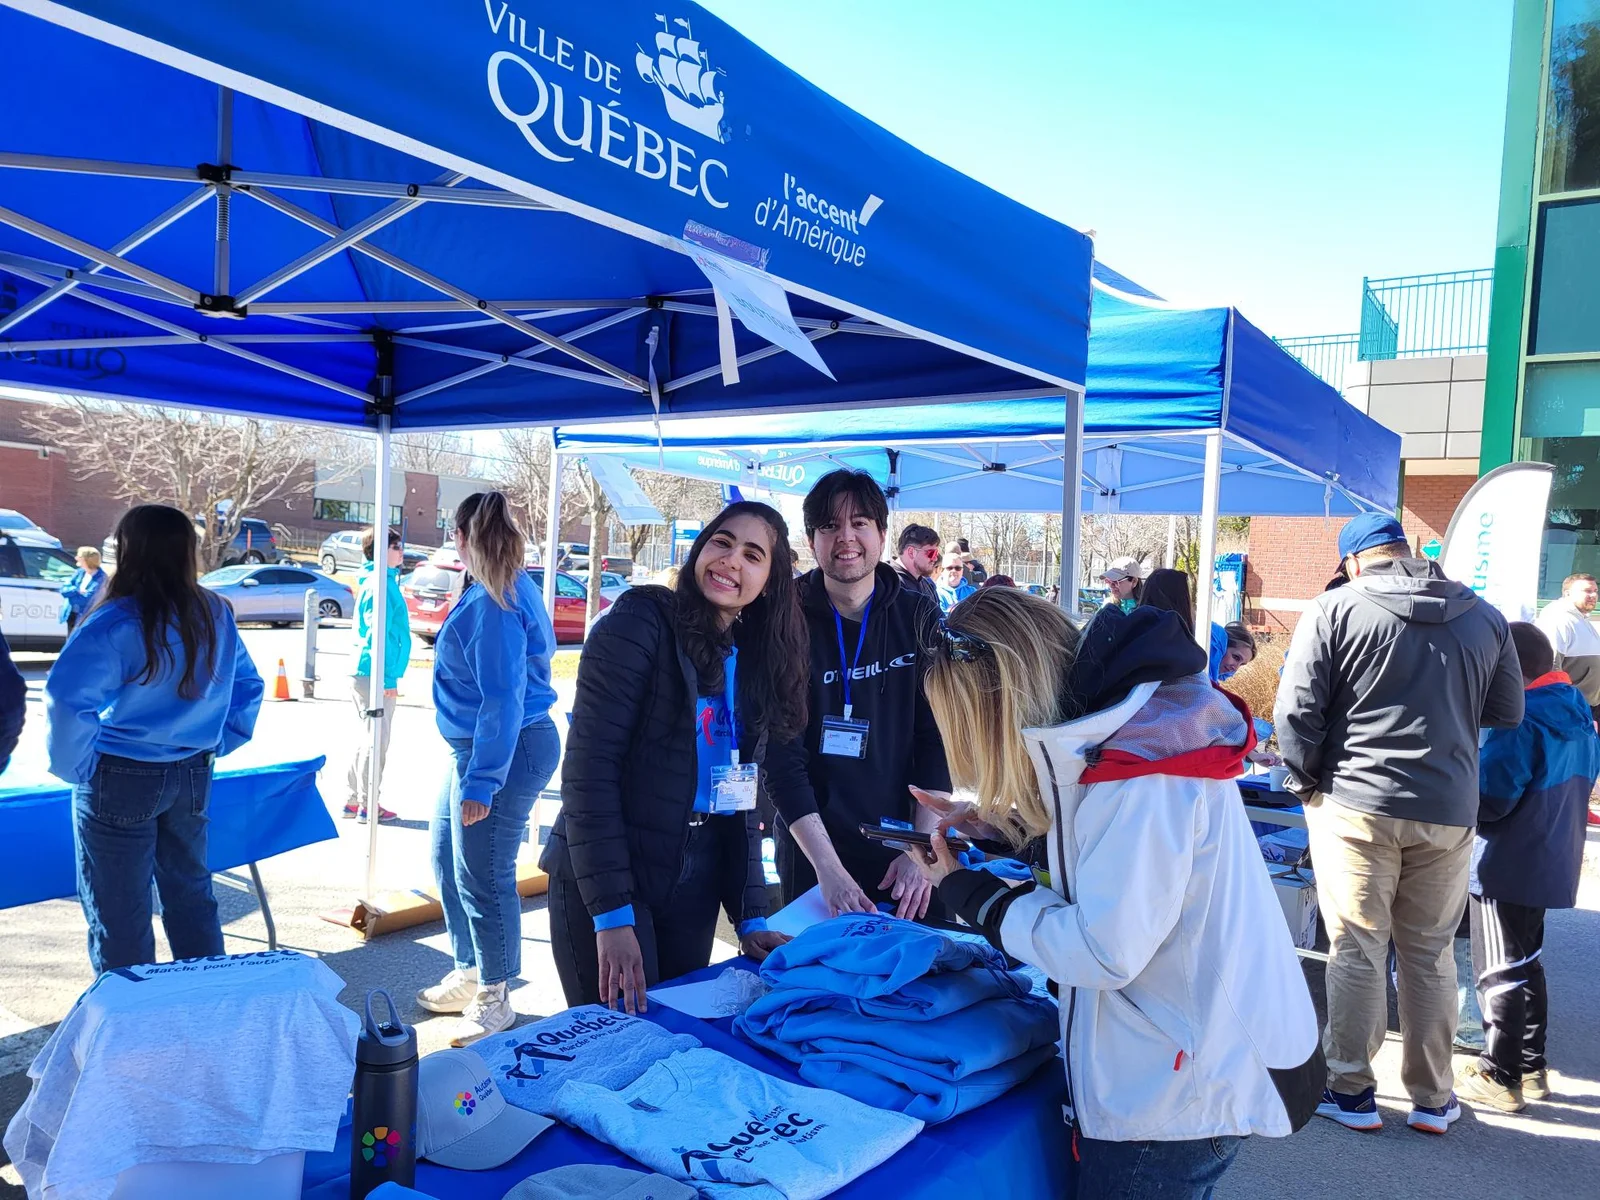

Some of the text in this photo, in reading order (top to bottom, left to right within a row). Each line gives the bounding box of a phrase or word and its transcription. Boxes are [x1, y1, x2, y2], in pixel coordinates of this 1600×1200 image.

[485, 0, 622, 95] VILLE DE
[487, 50, 730, 209] QUÉBEC
[754, 197, 867, 267] d'Amérique
[783, 172, 859, 235] l'accent
[1469, 512, 1494, 600] tisme
[145, 964, 198, 975] Marche
[204, 962, 236, 971] pour
